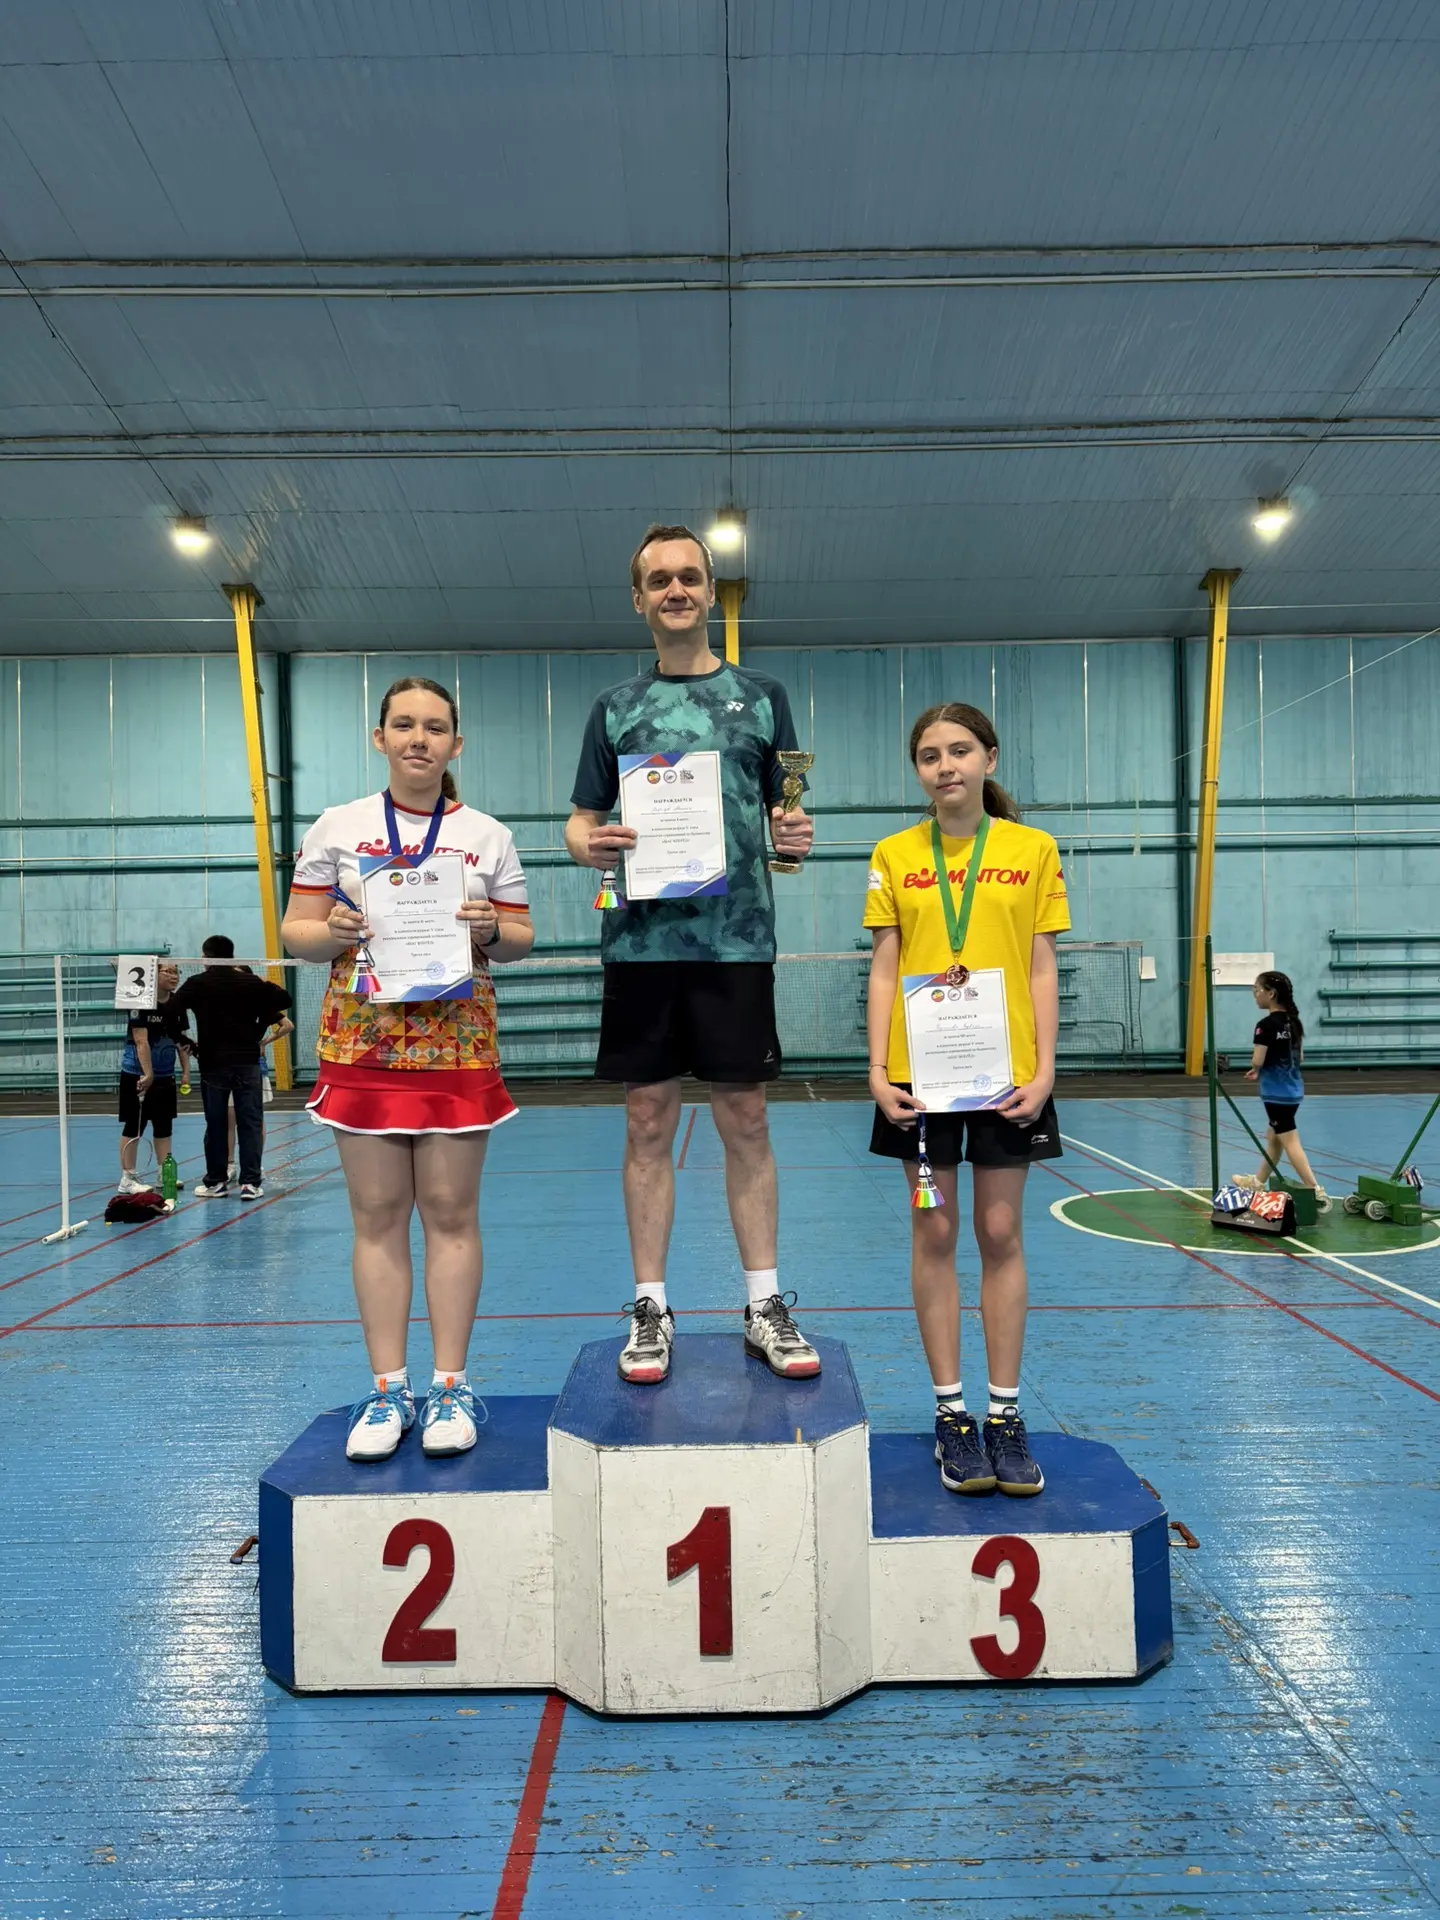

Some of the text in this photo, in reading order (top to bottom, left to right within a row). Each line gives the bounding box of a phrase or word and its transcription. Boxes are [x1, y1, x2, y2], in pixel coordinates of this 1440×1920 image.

[125, 966, 145, 998] 3
[382, 1518, 457, 1662] 2
[667, 1506, 733, 1657] 1
[970, 1535, 1046, 1680] 3
